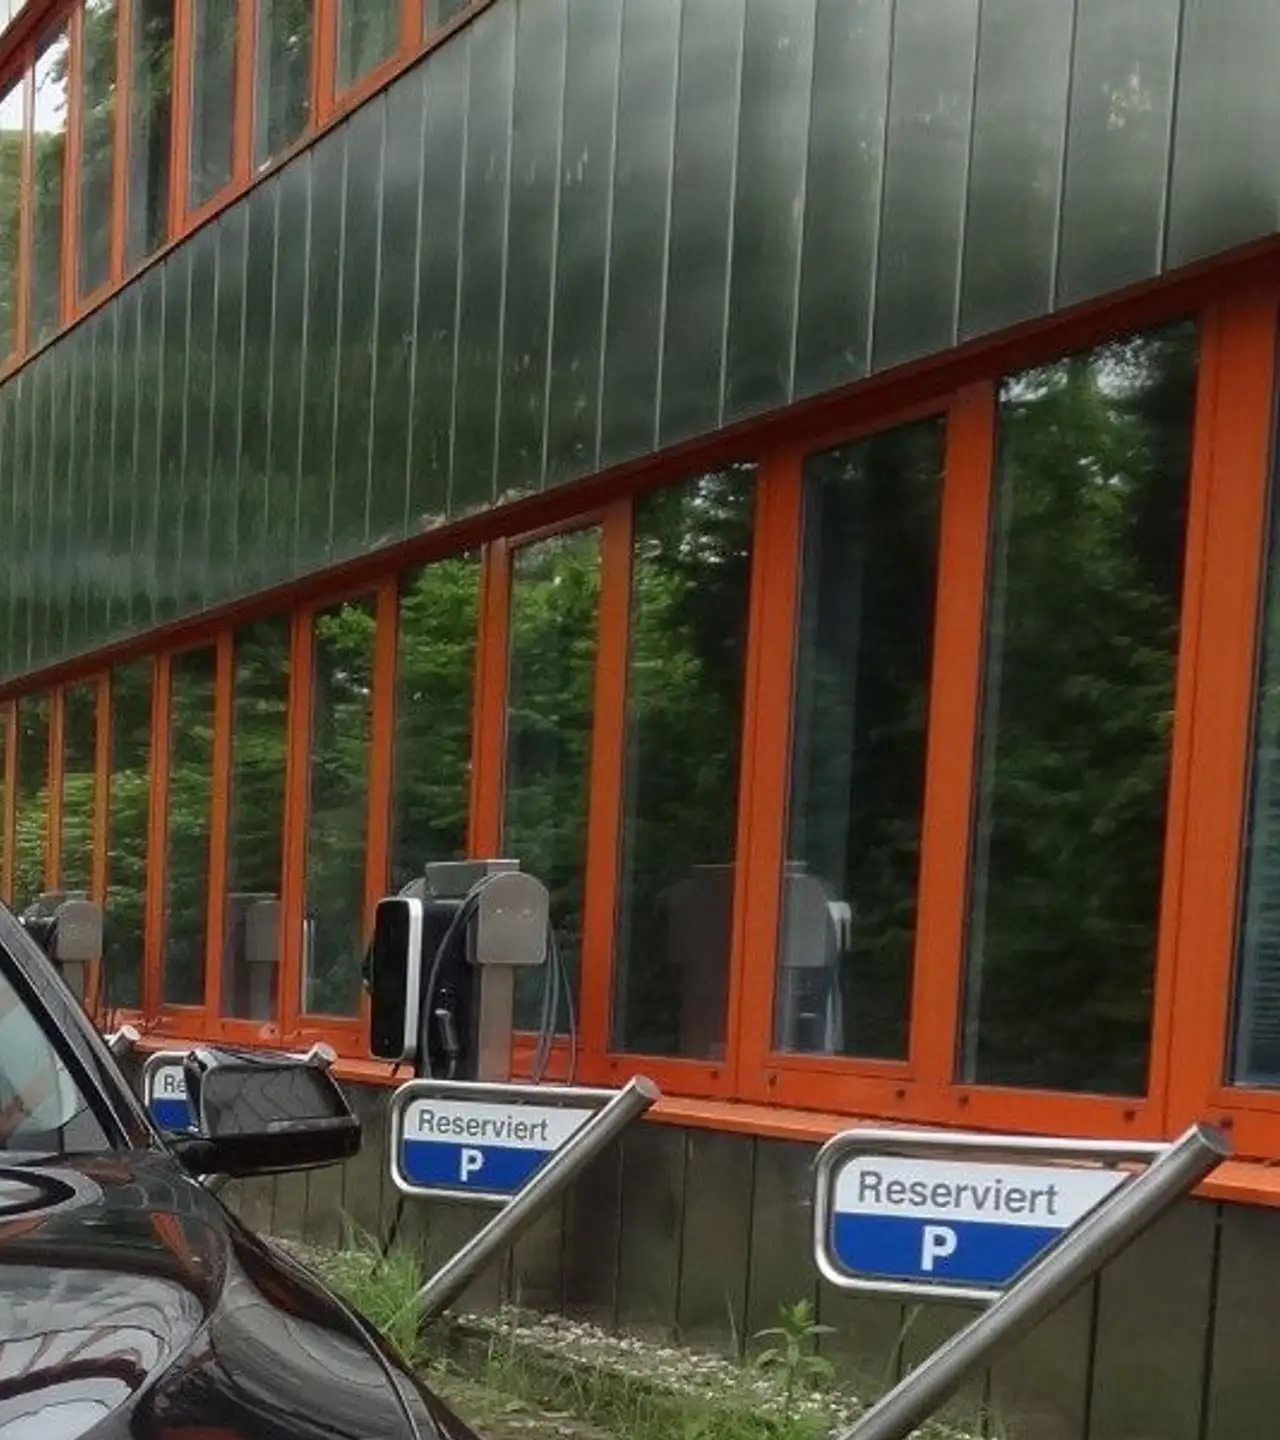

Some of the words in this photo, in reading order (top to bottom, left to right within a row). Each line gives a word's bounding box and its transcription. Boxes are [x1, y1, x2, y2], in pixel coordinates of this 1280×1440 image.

[417, 1108, 550, 1141] Reserviert
[459, 1147, 485, 1182] P
[857, 1170, 1060, 1216] Reserviert
[920, 1225, 958, 1272] P
